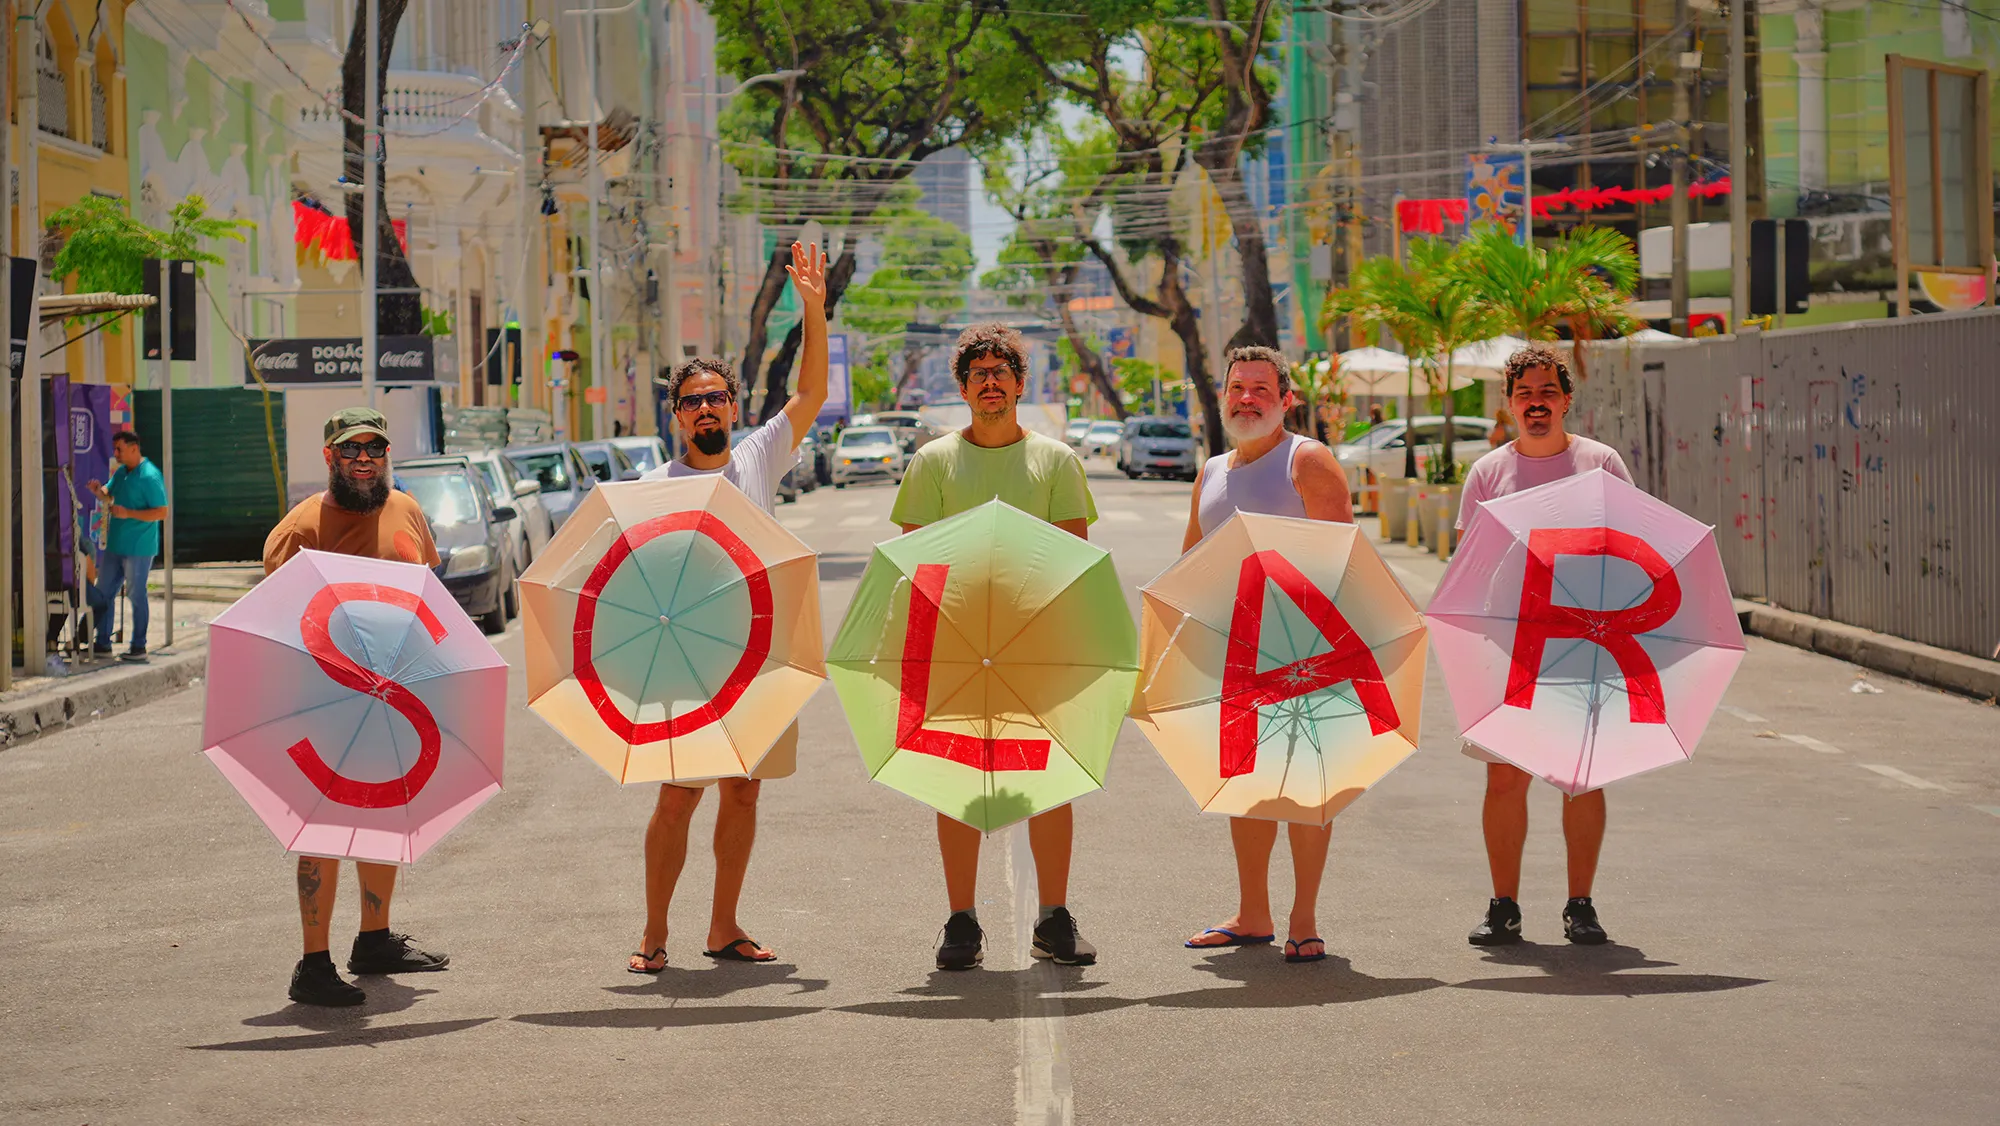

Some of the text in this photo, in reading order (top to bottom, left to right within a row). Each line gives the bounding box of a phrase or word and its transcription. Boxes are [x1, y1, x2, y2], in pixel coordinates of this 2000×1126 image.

[314, 361, 337, 374] DO
[286, 582, 448, 809] S
[573, 510, 773, 745] O
[896, 564, 1051, 772] L
[1219, 550, 1401, 778] A
[1503, 527, 1682, 723] R
